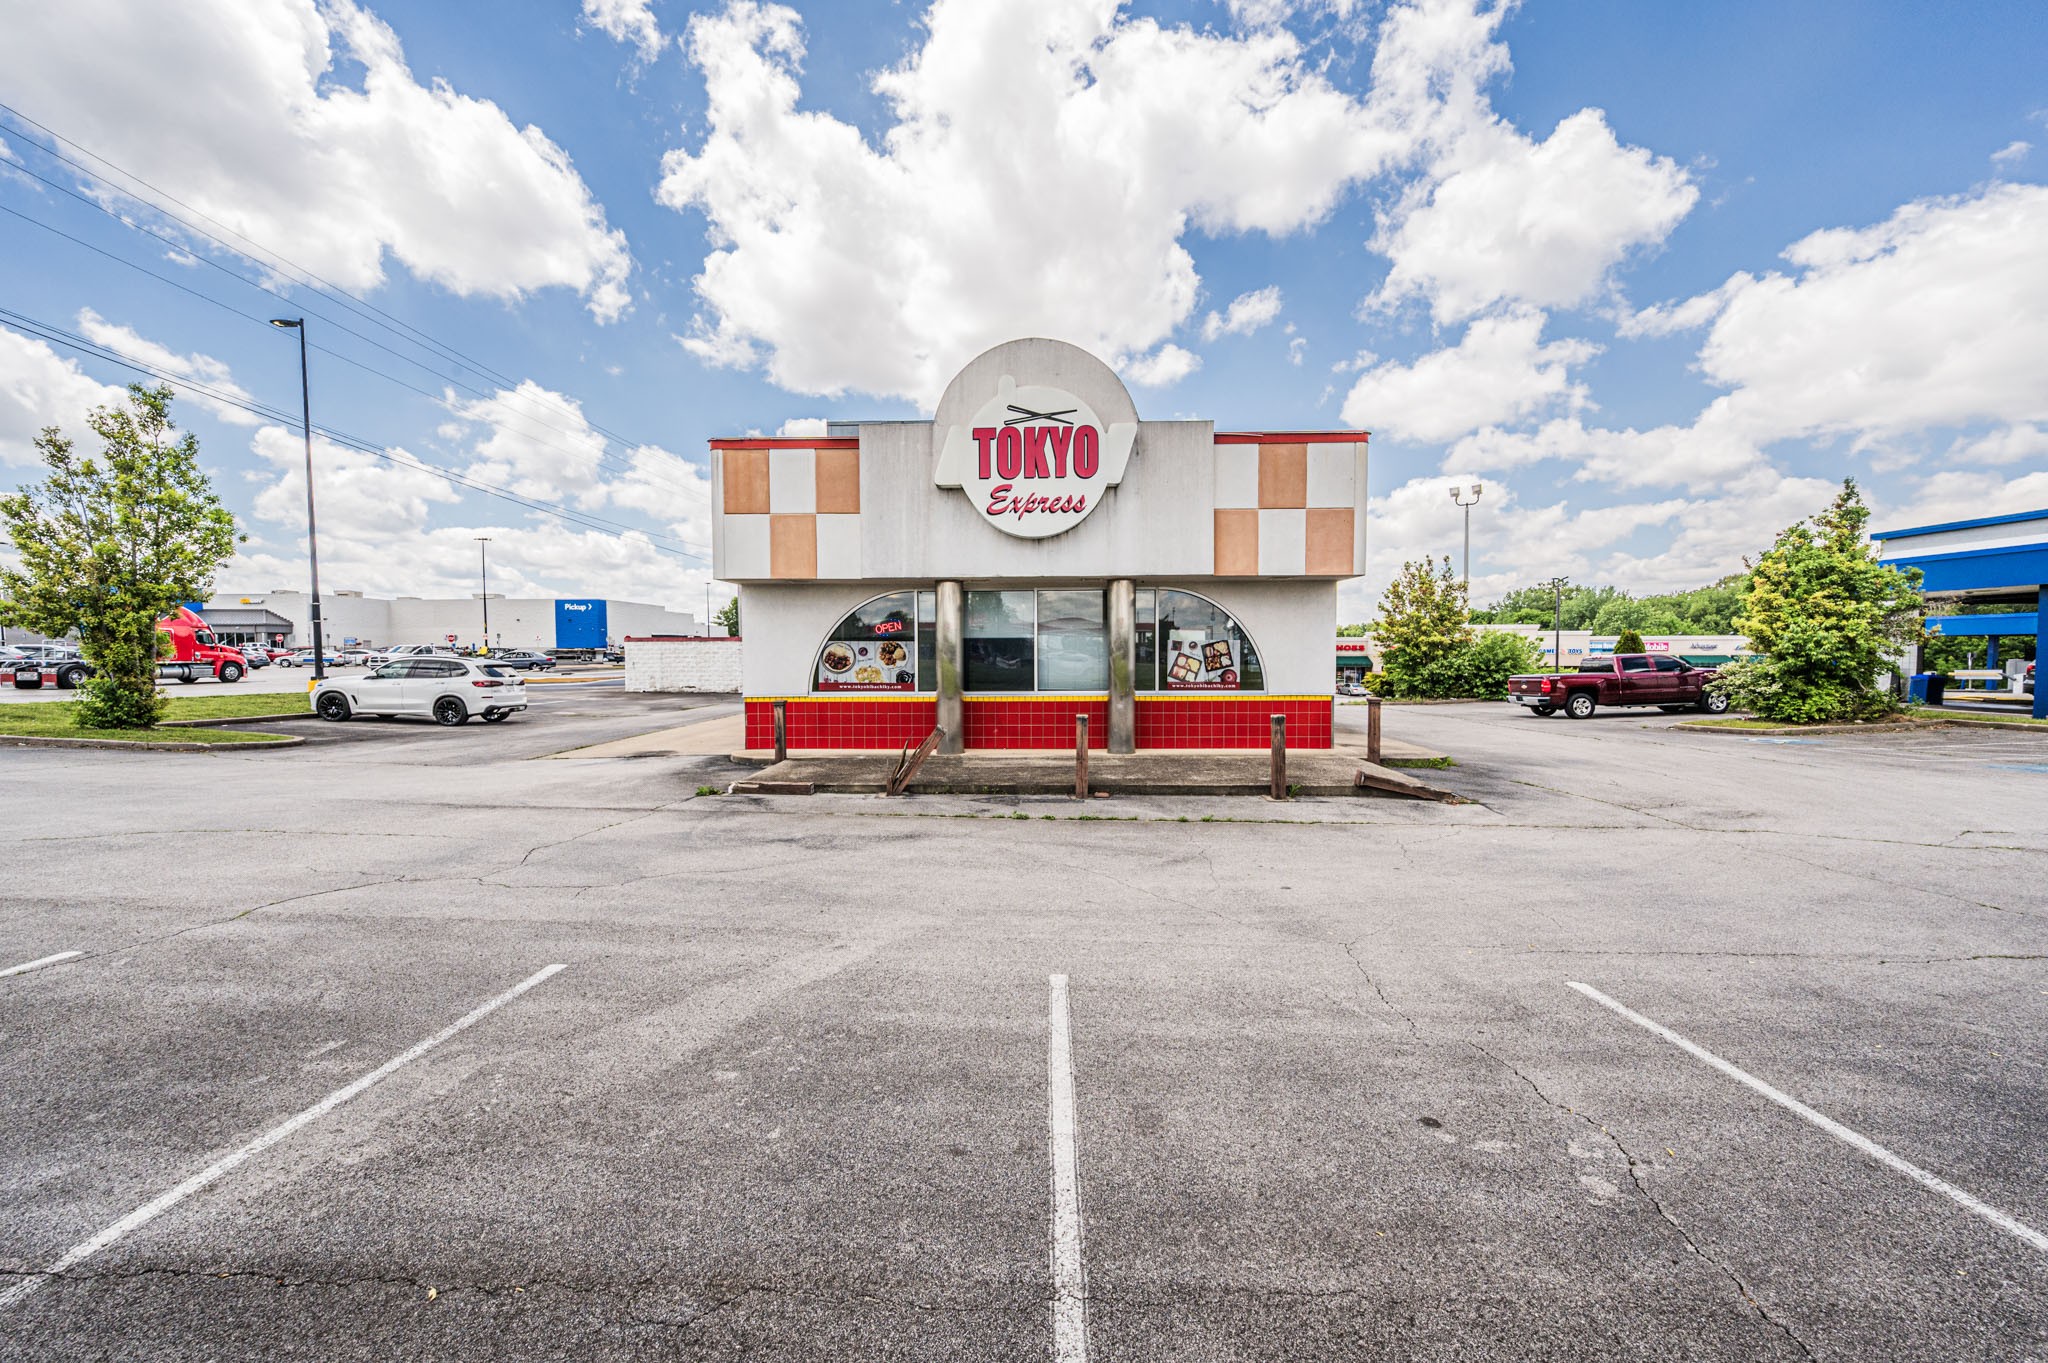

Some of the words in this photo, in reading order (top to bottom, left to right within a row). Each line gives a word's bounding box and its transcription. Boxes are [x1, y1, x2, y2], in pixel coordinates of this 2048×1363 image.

[973, 425, 1099, 480] TOKYO
[986, 483, 1087, 520] Express
[564, 603, 587, 612] Pickup
[875, 621, 902, 634] OPEN
